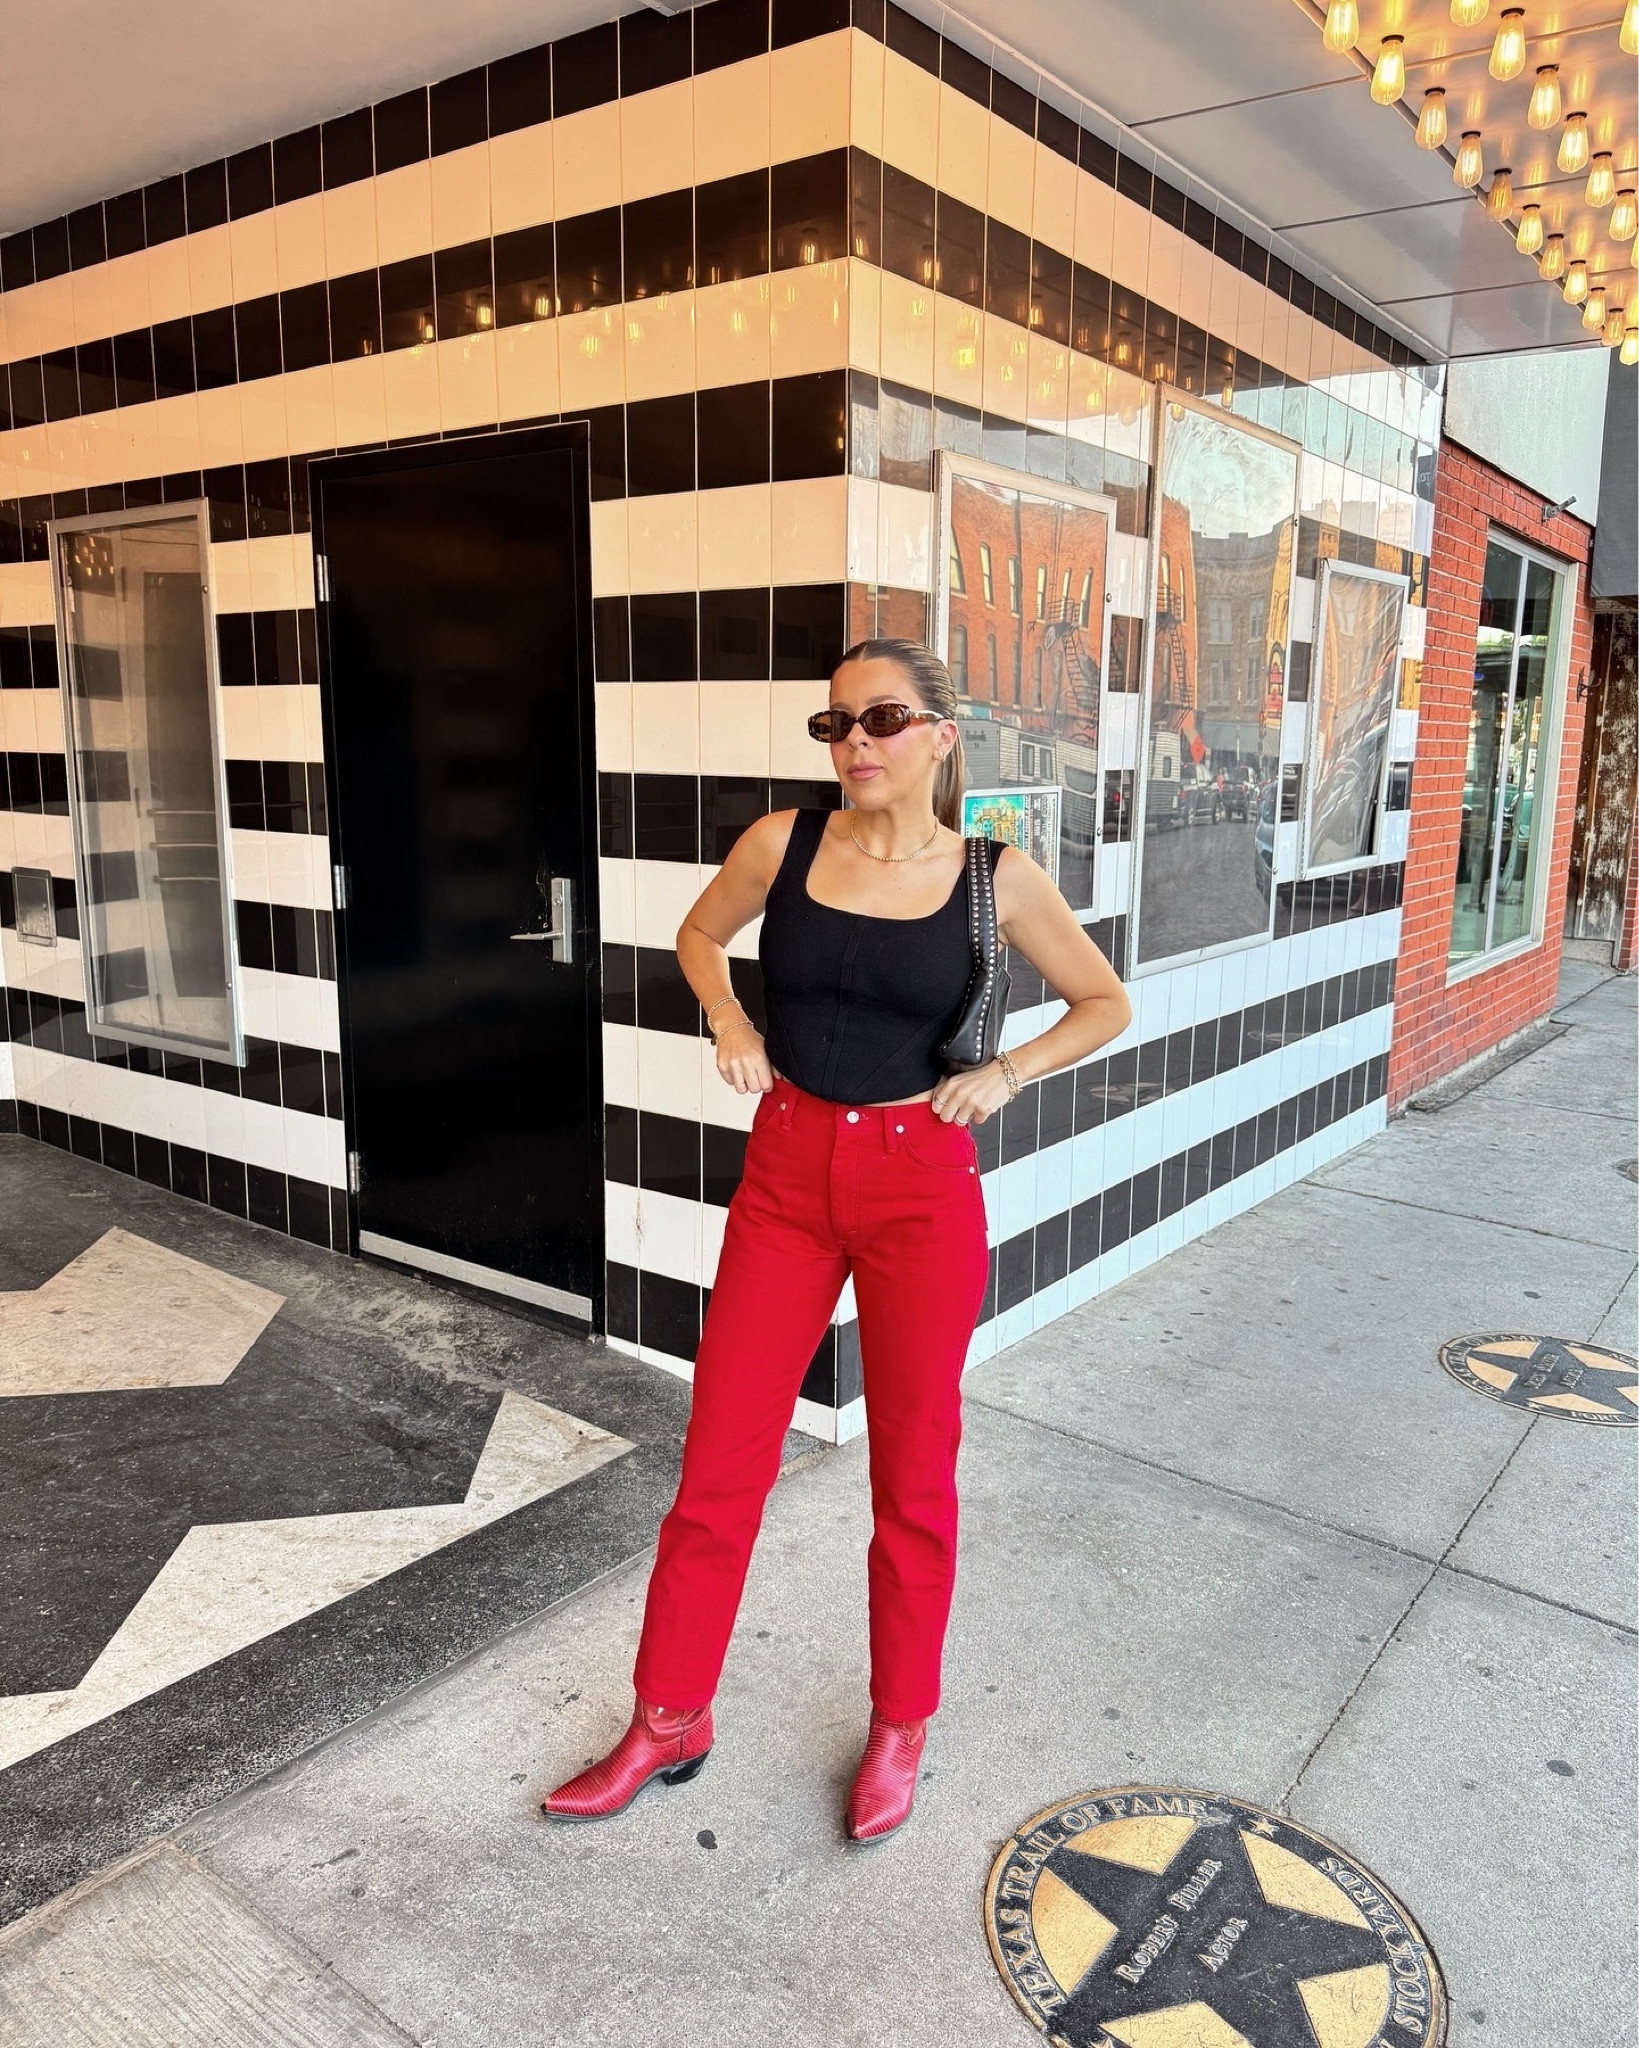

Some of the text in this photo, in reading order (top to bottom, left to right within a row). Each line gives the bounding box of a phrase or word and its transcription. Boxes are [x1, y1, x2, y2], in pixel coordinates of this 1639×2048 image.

[999, 1796, 1208, 2016] TEXAS TRAIL OF FAME
